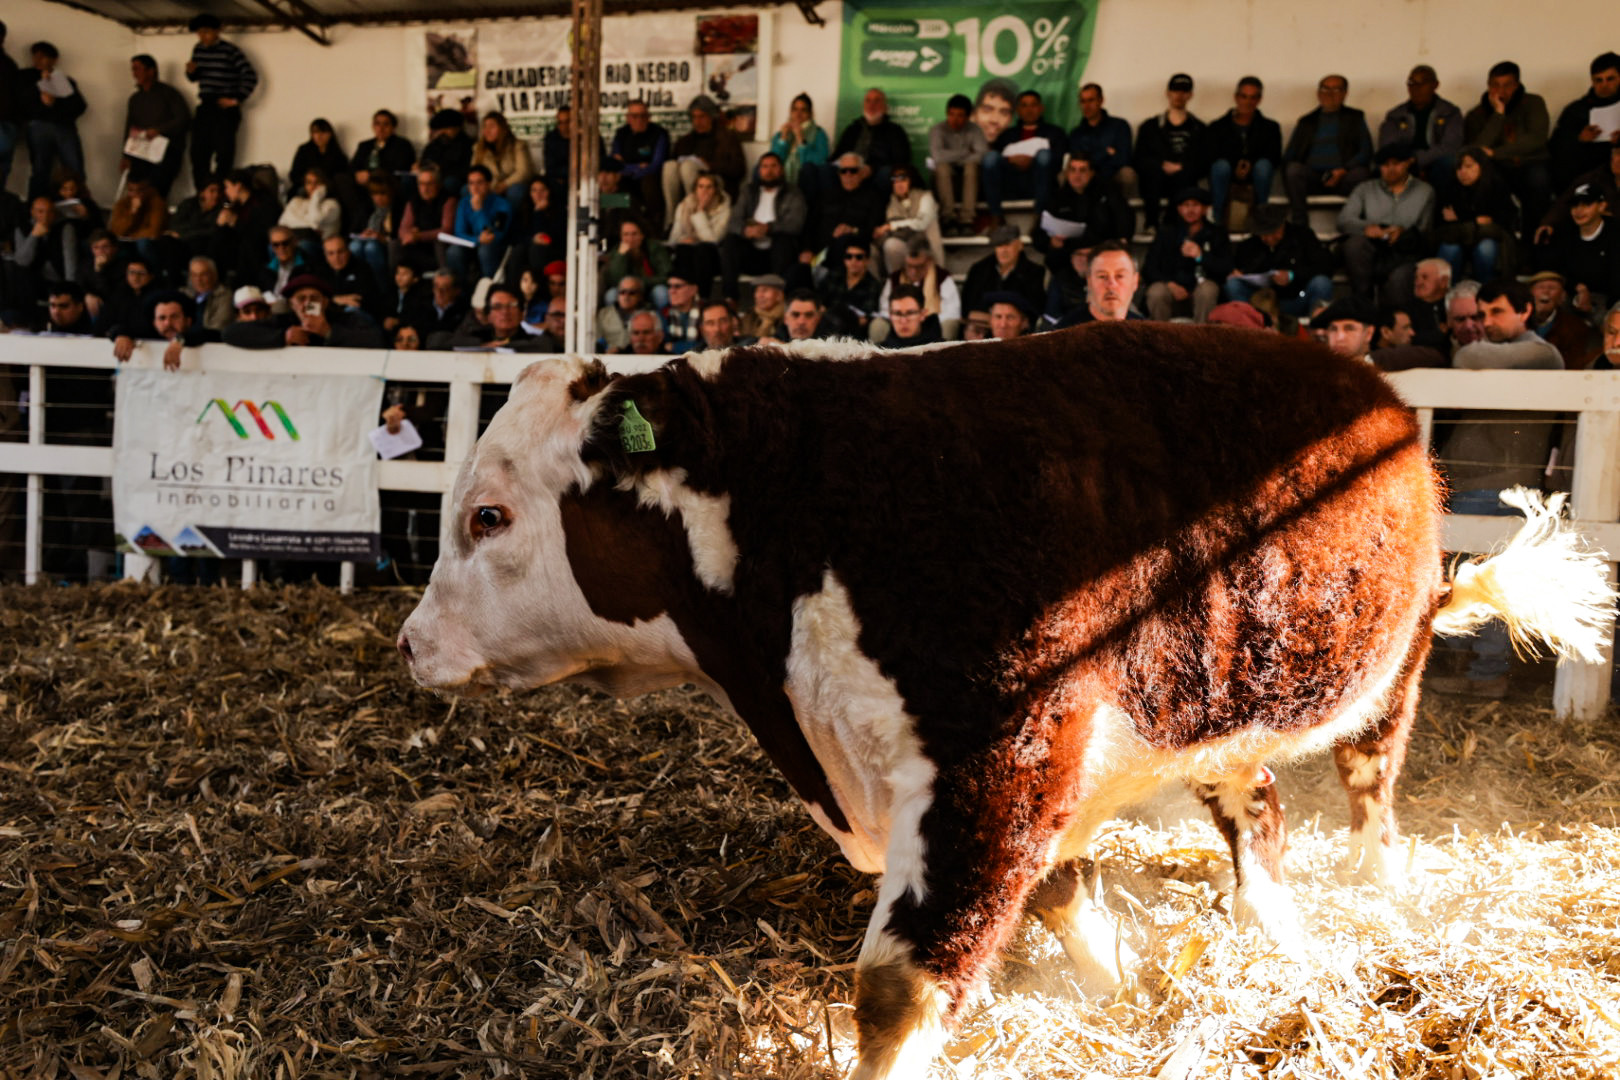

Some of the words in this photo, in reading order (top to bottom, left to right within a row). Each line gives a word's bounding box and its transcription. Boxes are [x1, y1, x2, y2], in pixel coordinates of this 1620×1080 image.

[485, 66, 572, 90] GANADERO
[606, 64, 631, 84] RIO
[637, 61, 690, 82] NEGRO
[510, 91, 530, 112] LA
[150, 452, 204, 483] Los
[226, 456, 343, 488] Pinares
